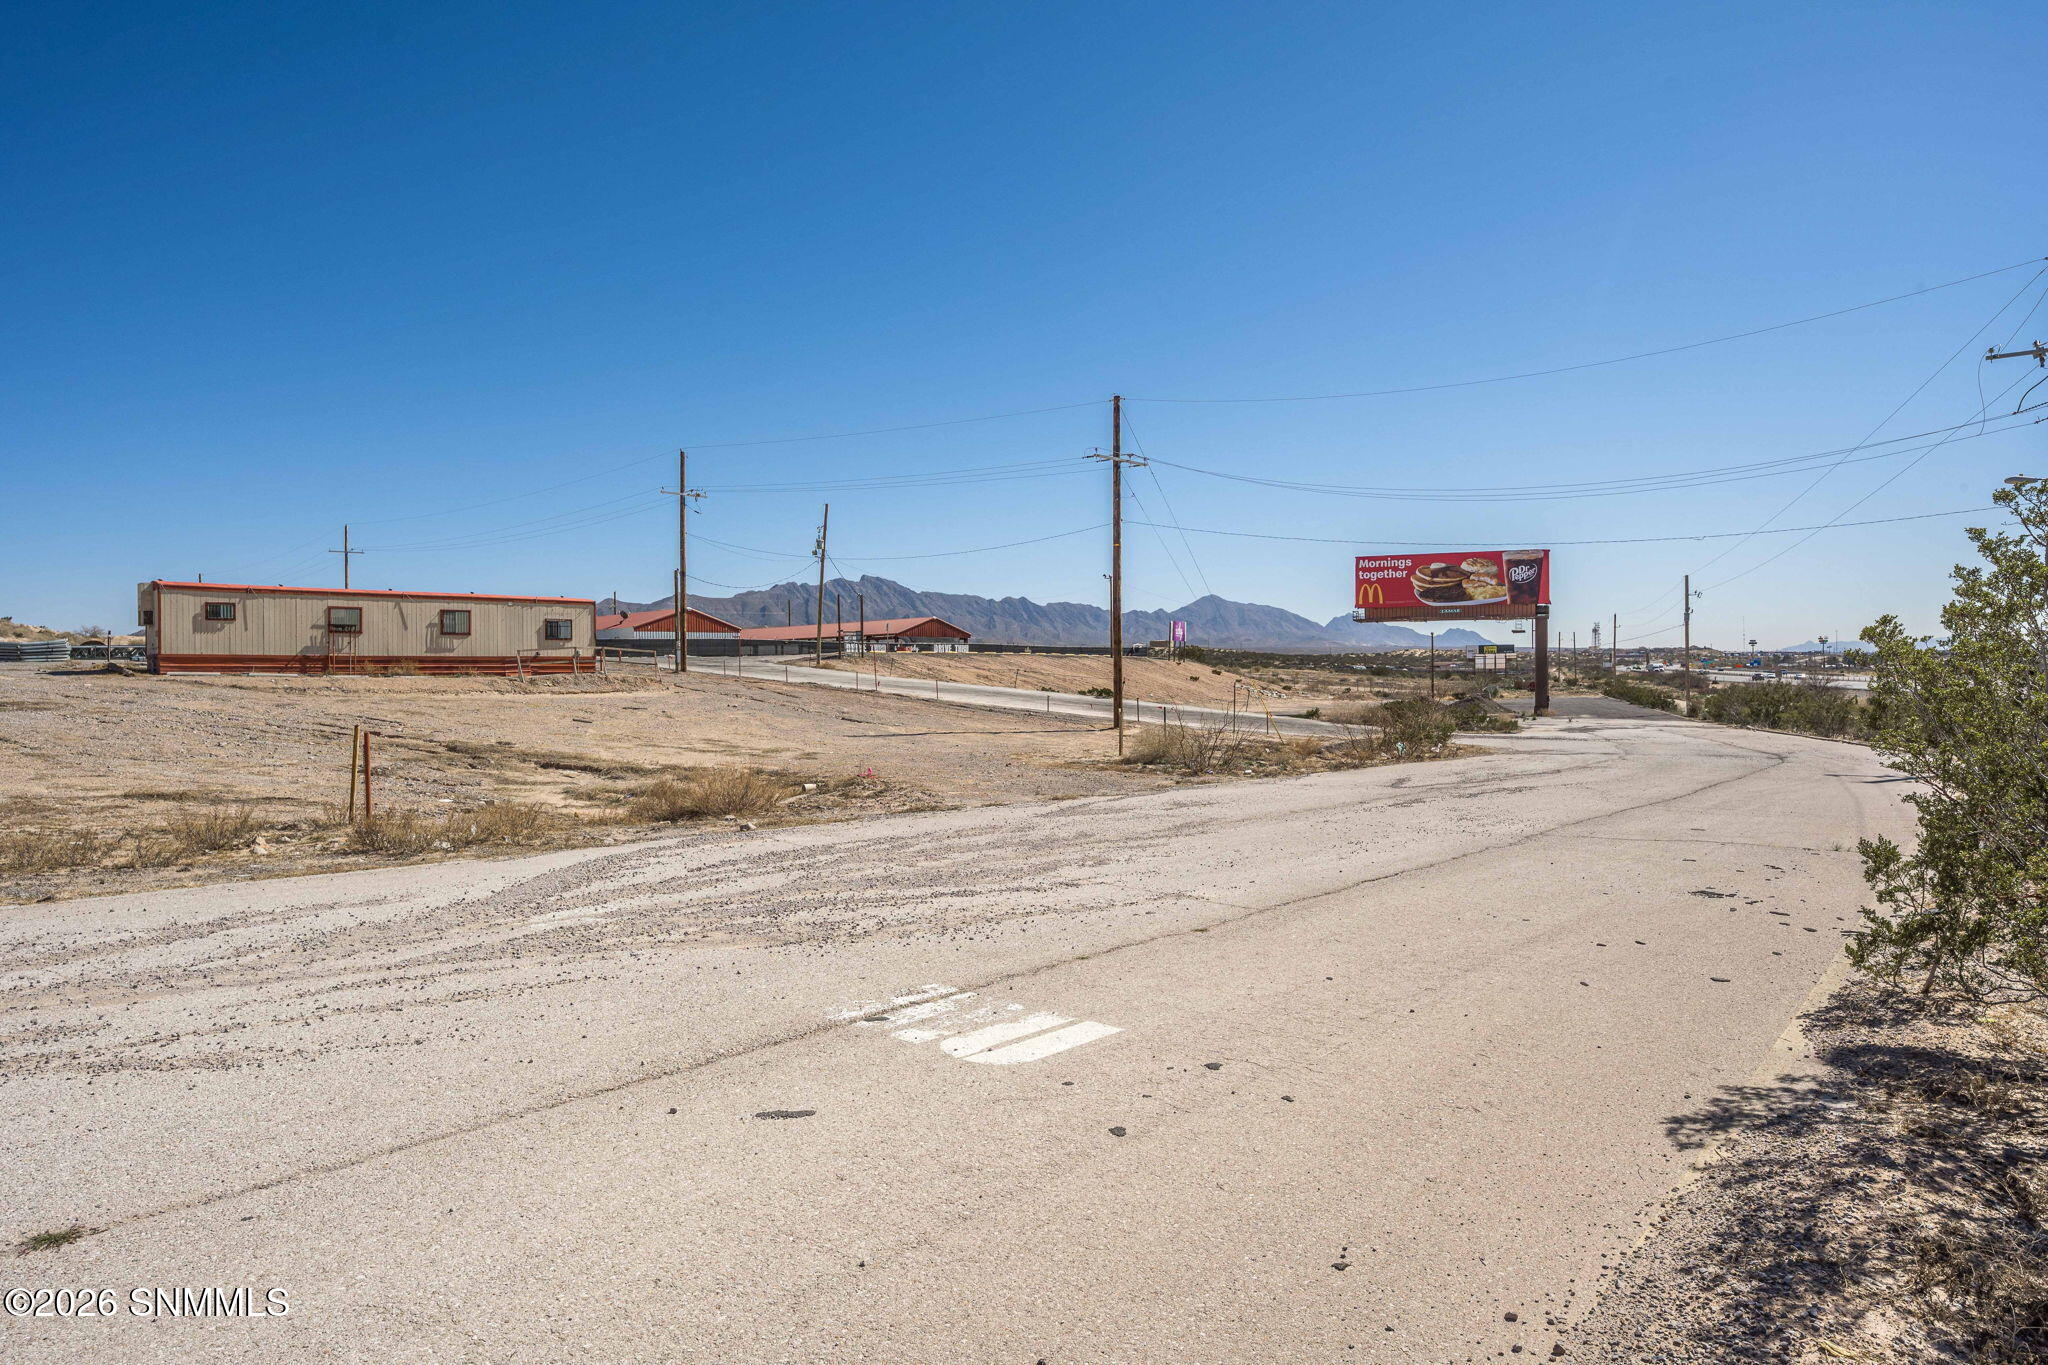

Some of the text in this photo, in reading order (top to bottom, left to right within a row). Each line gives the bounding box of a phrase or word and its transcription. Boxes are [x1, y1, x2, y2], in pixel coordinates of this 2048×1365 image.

[1358, 557, 1412, 569] Mornings
[1358, 569, 1408, 581] together
[1509, 567, 1536, 582] Pepper
[1518, 565, 1530, 574] Dr
